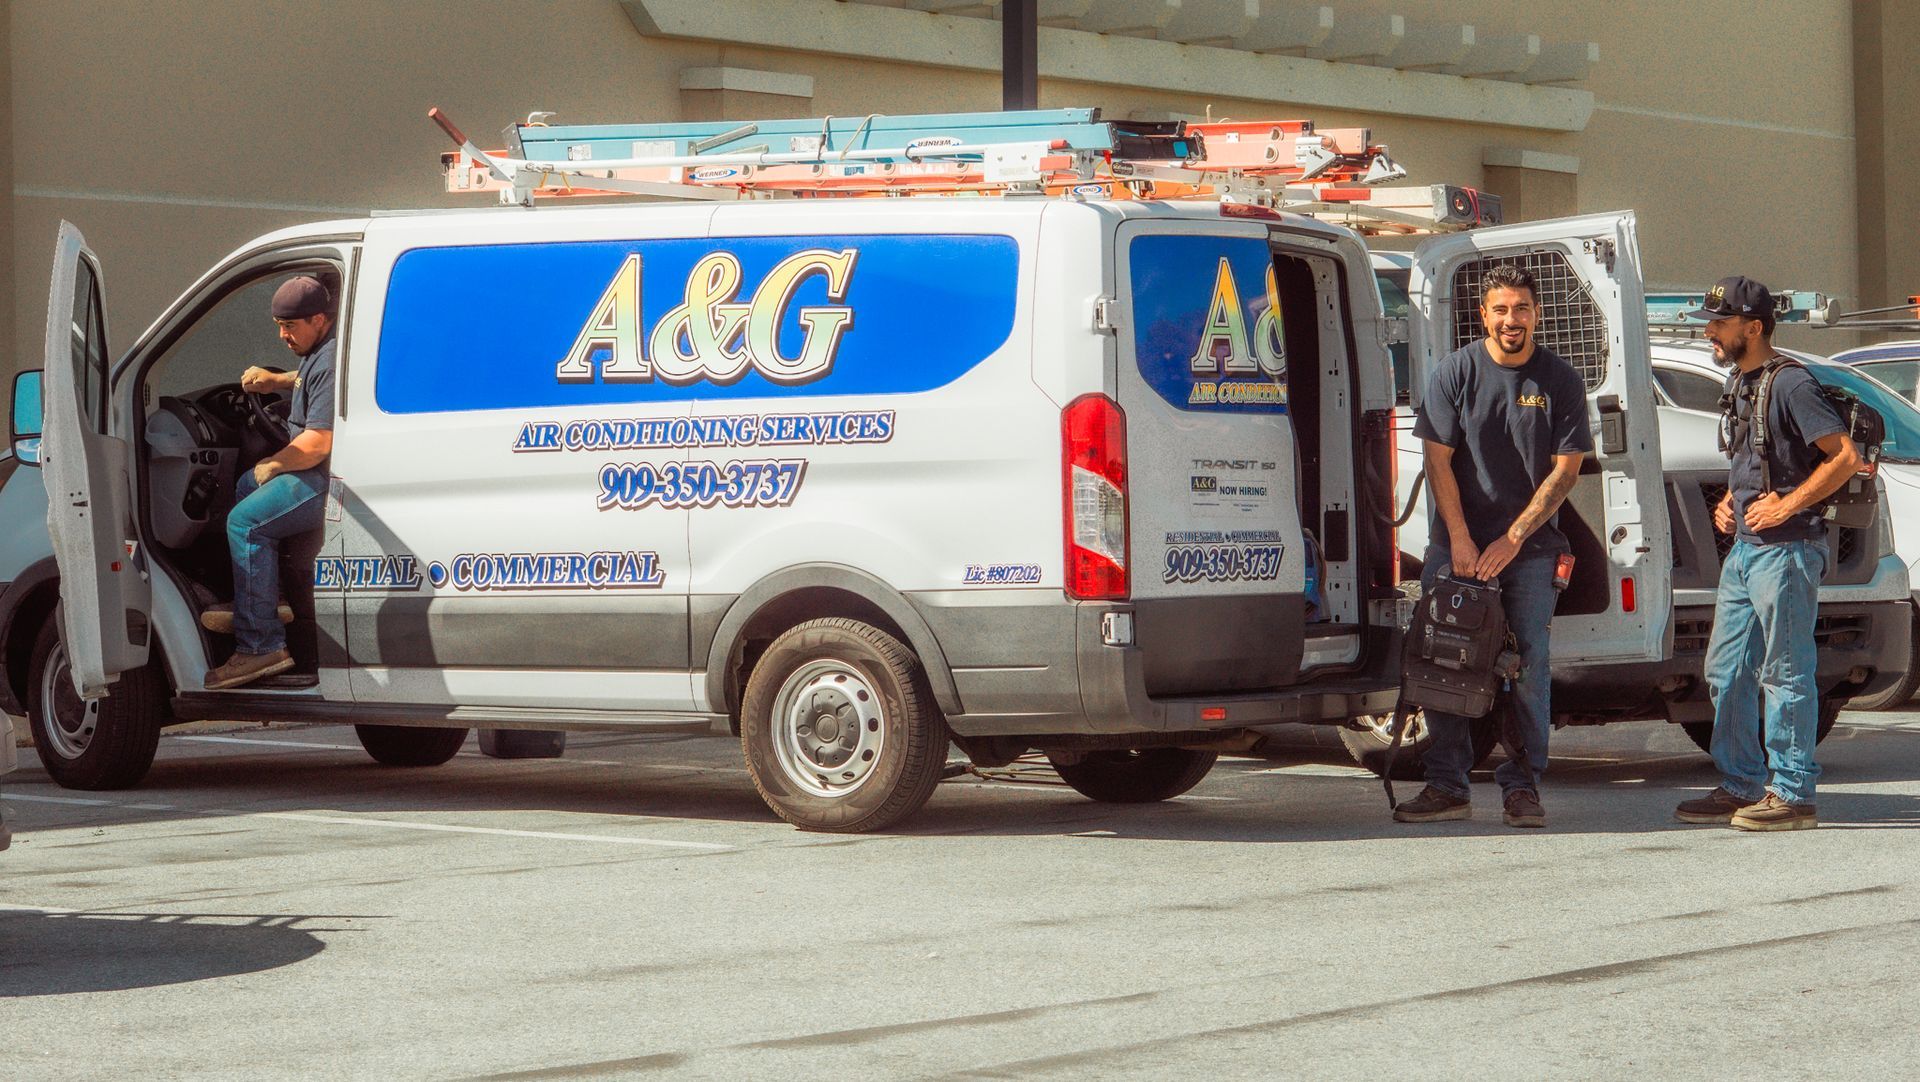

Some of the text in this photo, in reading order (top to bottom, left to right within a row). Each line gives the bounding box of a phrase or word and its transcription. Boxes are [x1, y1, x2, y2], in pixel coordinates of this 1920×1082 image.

[917, 138, 951, 147] WERNER
[698, 169, 728, 178] WERNER
[556, 248, 859, 387] A&G
[1189, 382, 1218, 405] AIR
[1516, 394, 1545, 405] A&G
[513, 410, 896, 453] AIR CONDITIONING SERVICES
[1192, 459, 1258, 470] TRANSIT
[597, 459, 807, 512] 909-350-3737
[1192, 476, 1216, 489] A&G
[1219, 486, 1237, 496] NOW
[1239, 486, 1267, 497] HIRING!
[450, 551, 667, 592] COMMERCIAL
[963, 563, 1041, 585] Lic #807202
[1162, 544, 1284, 584] 909-350-3737
